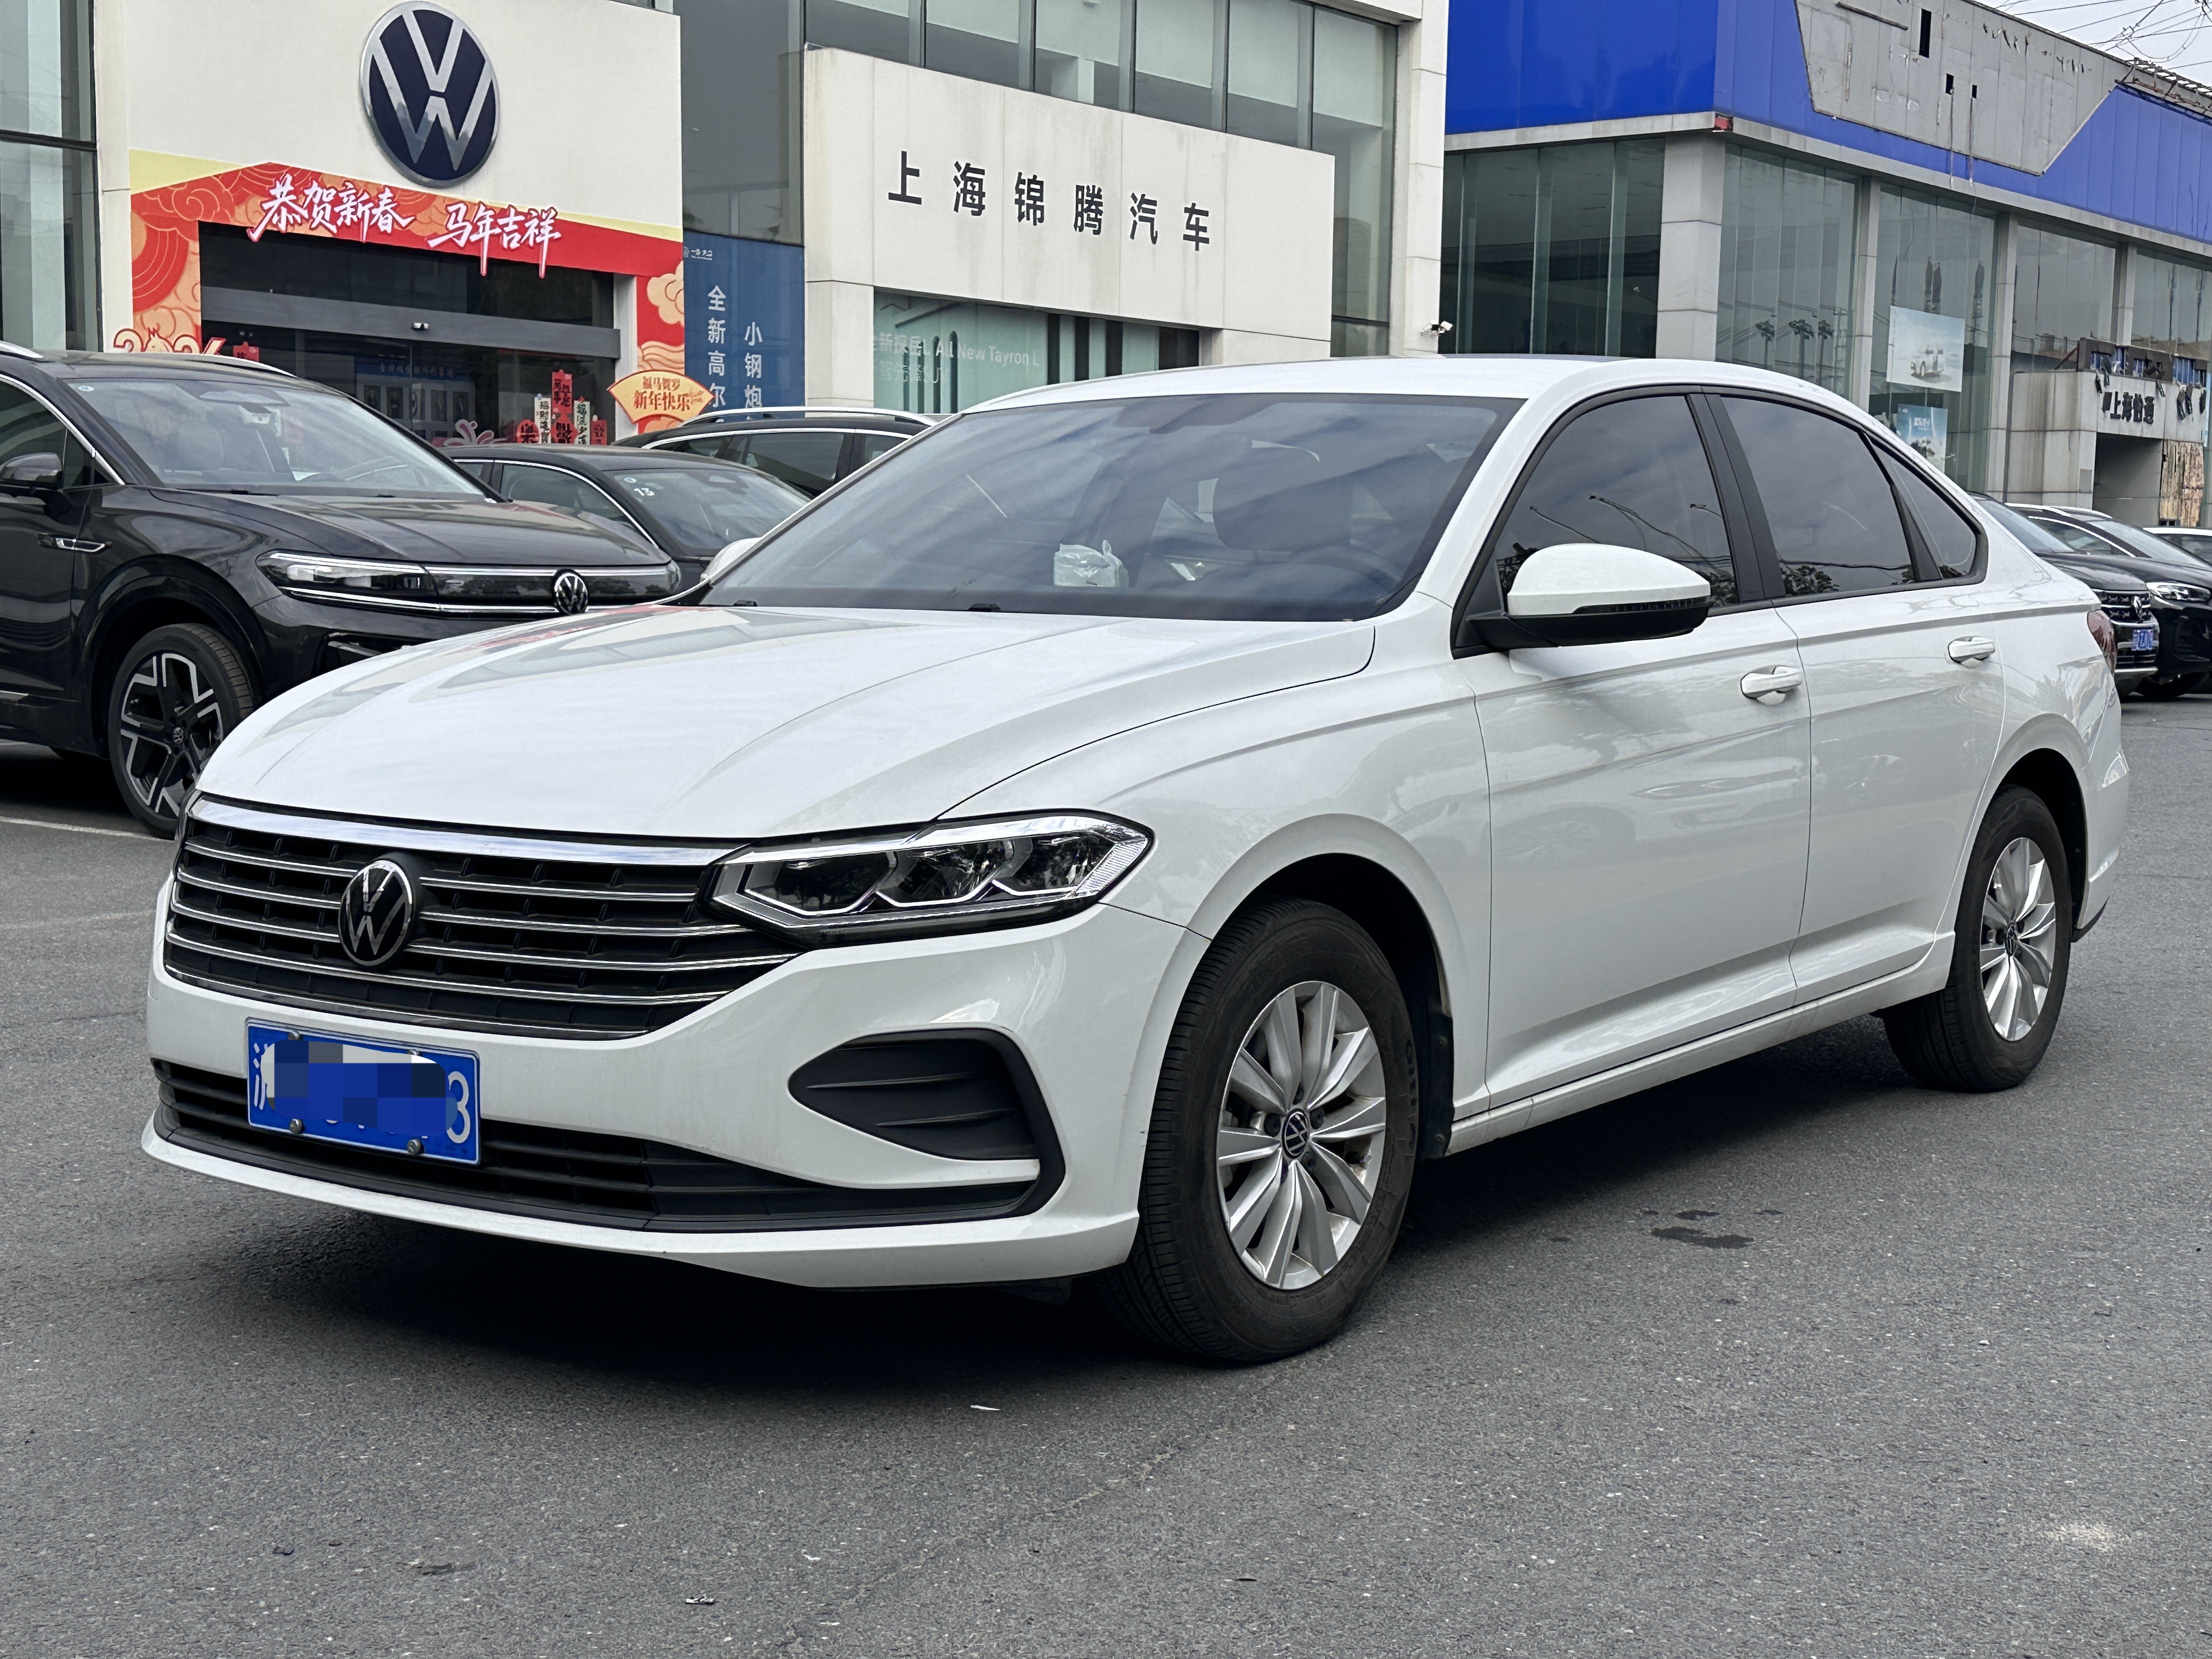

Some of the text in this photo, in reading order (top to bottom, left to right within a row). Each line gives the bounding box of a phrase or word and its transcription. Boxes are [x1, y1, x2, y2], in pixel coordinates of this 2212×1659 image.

[247, 173, 561, 279] 恭贺新春 马年吉祥
[888, 150, 1210, 251] 上海锦腾汽车
[634, 390, 690, 411] 新年快乐
[708, 285, 726, 423] 全新高尔
[744, 321, 763, 421] 小钢炮
[988, 346, 1029, 367] Tayron
